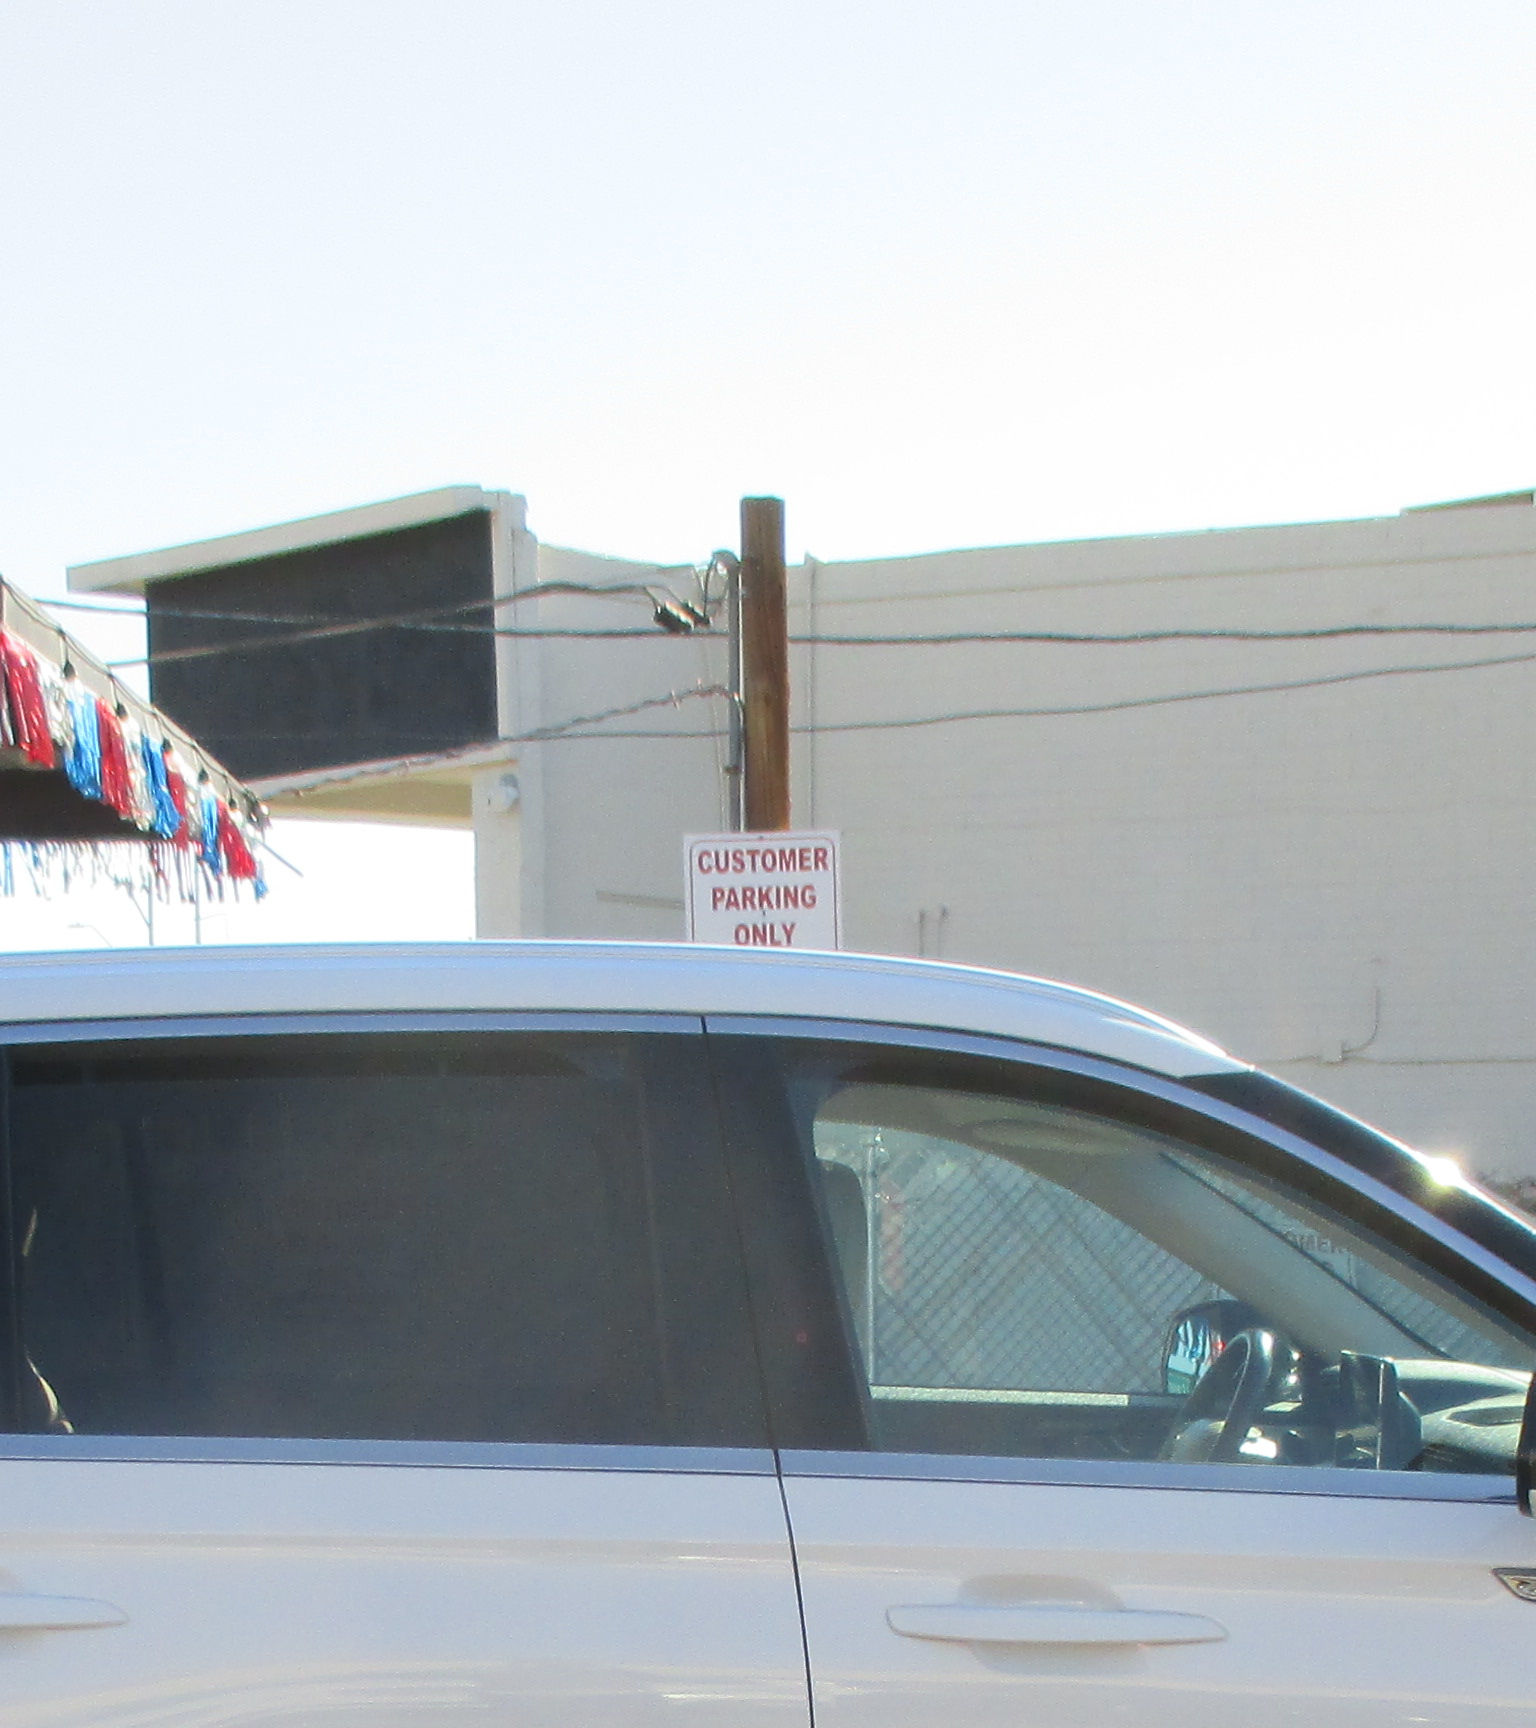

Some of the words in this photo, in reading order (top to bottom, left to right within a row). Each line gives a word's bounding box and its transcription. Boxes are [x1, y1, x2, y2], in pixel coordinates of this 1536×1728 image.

[697, 847, 831, 875] CUSTOMER
[711, 884, 817, 912] PARKING
[734, 922, 796, 946] ONLY
